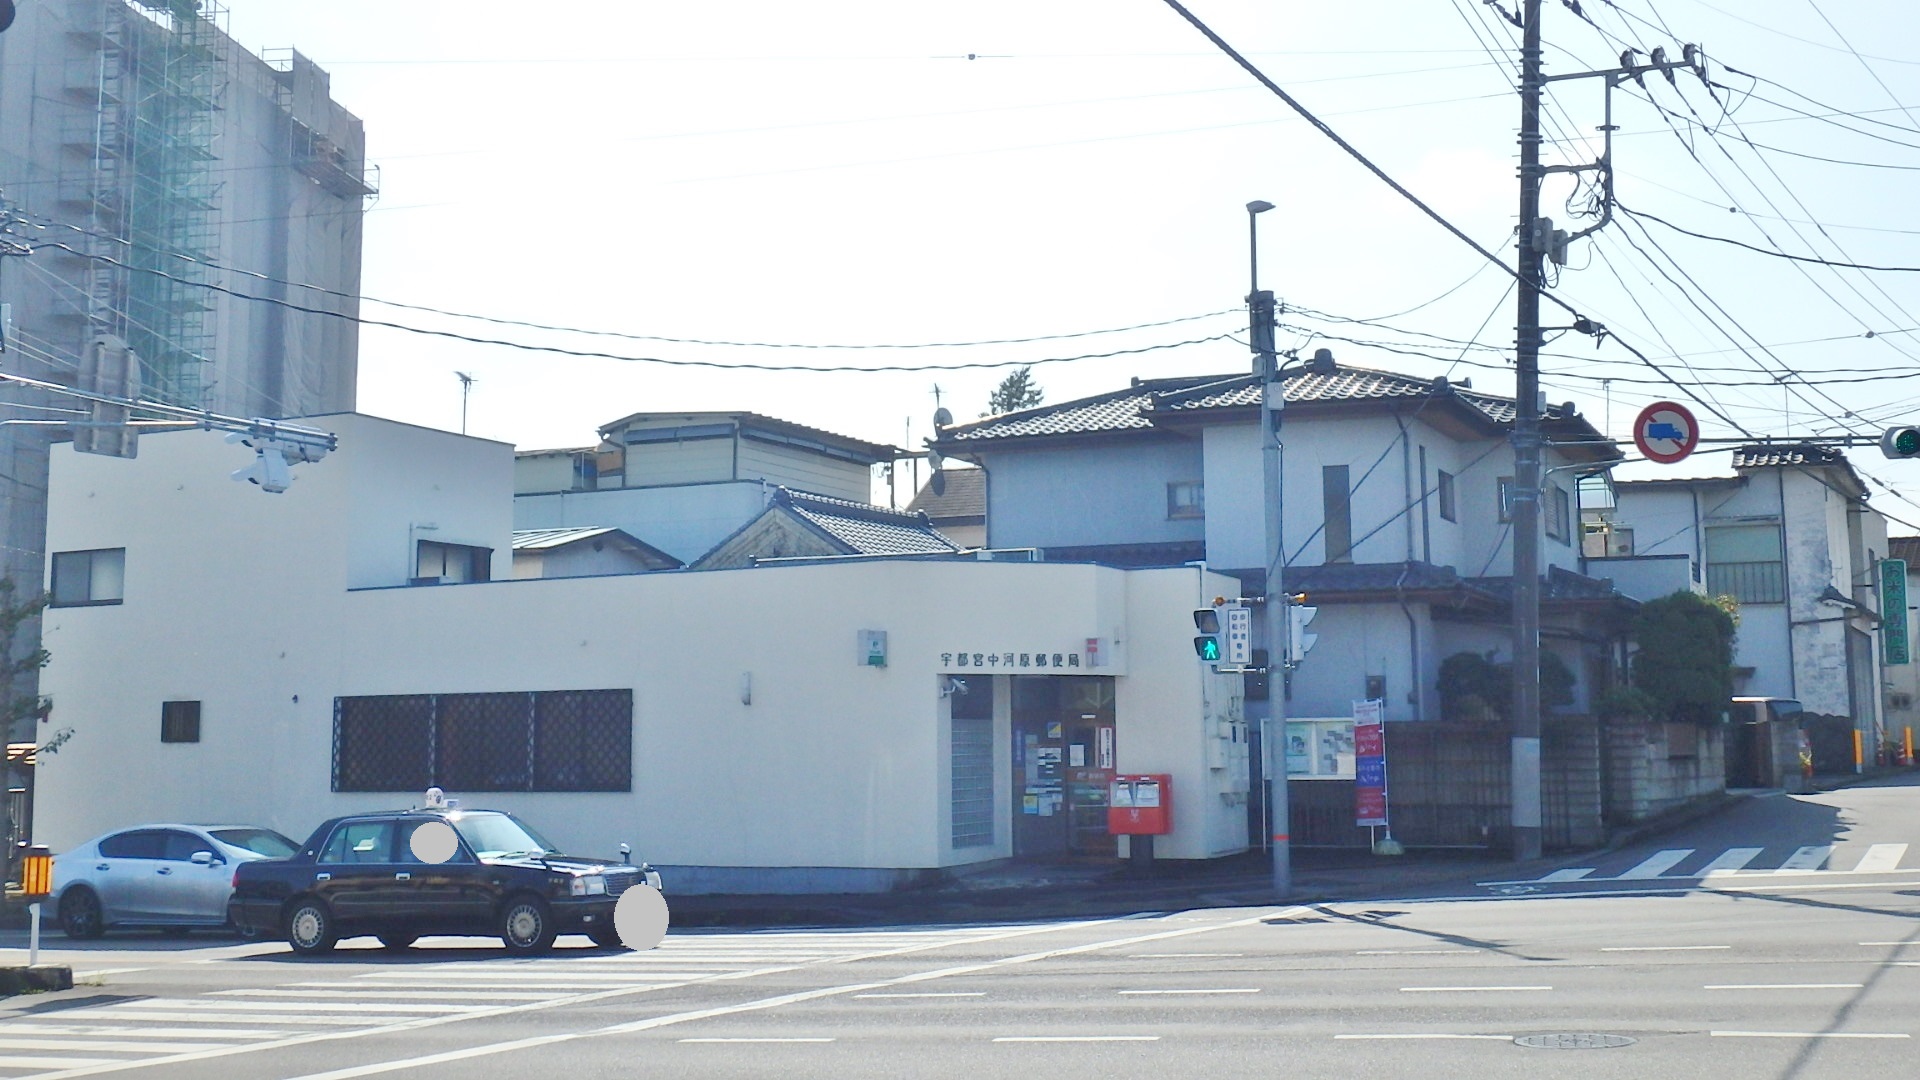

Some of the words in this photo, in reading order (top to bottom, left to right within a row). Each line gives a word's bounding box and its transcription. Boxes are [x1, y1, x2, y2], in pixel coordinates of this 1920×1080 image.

[940, 652, 1080, 667] 宇都宮中河原郵便局
